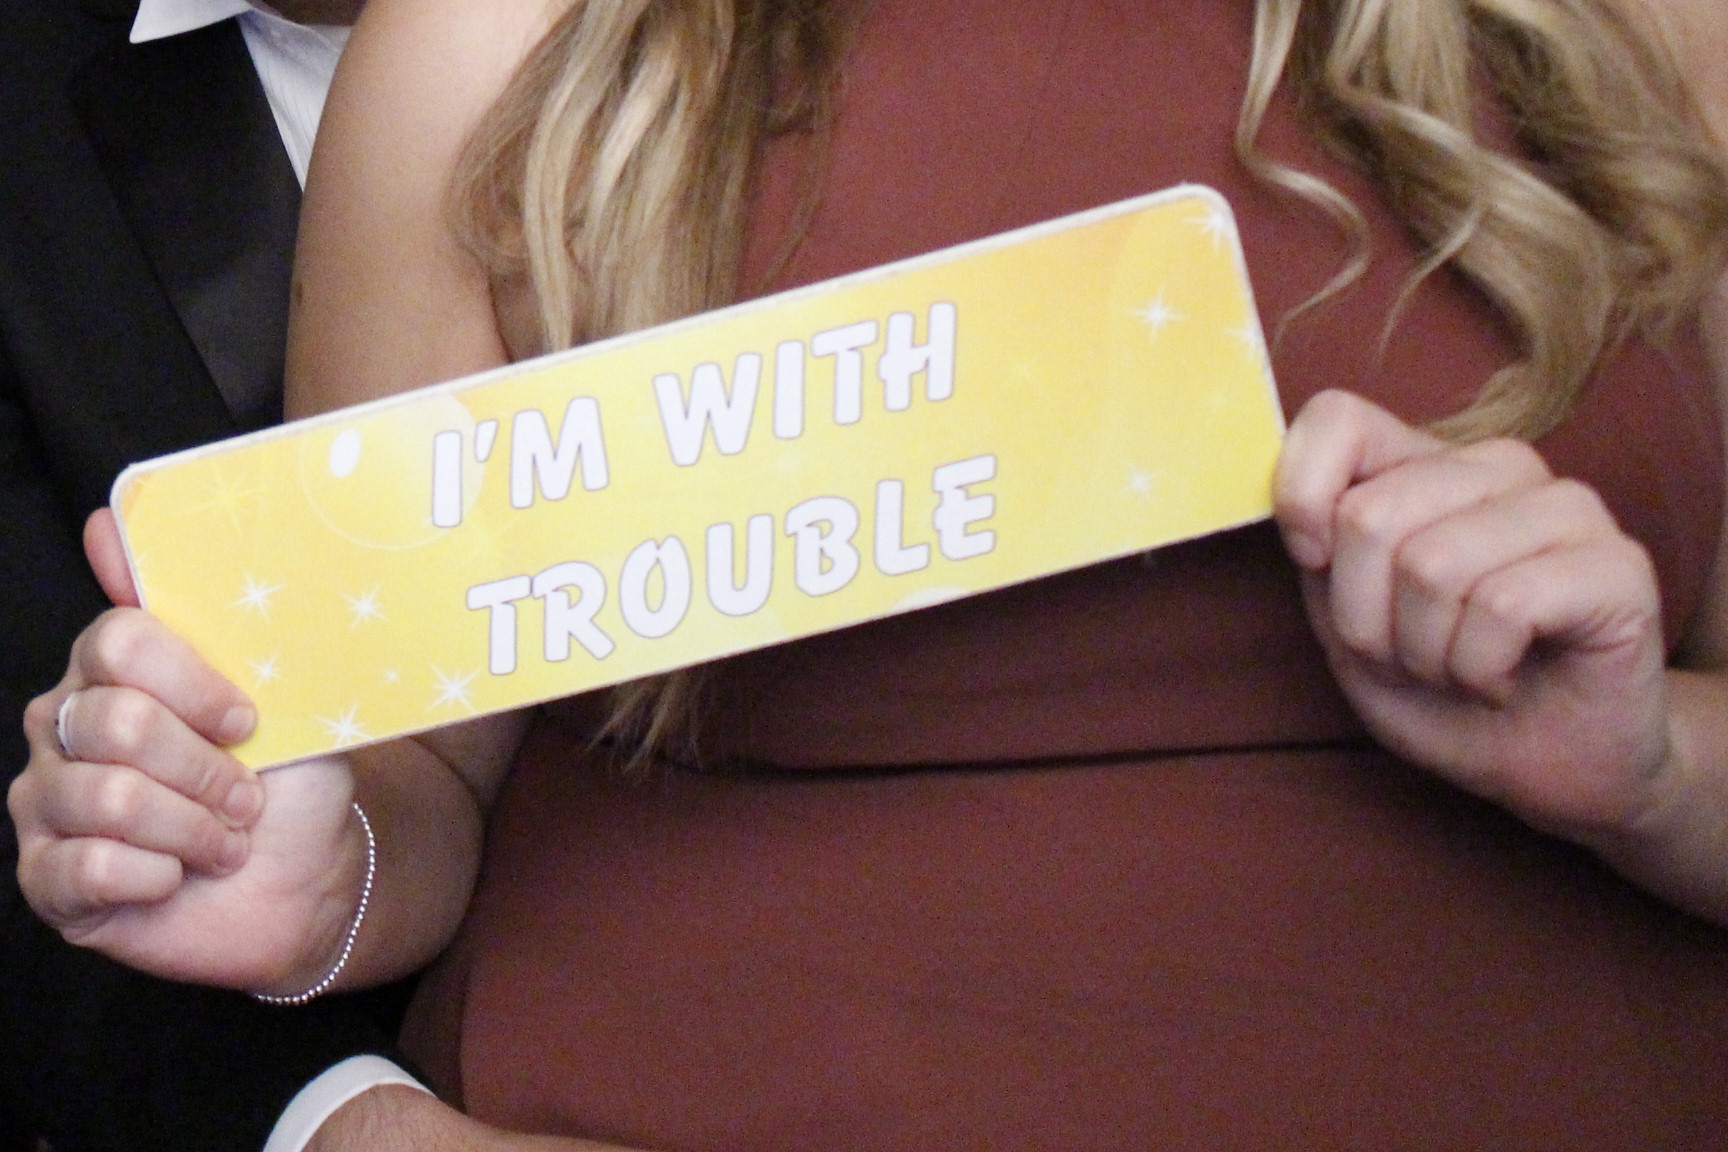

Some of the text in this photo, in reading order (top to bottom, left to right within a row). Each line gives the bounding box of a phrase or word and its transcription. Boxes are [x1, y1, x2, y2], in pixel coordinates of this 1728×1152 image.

[431, 302, 957, 528] I'M WITH
[467, 455, 998, 676] TROUBLE
